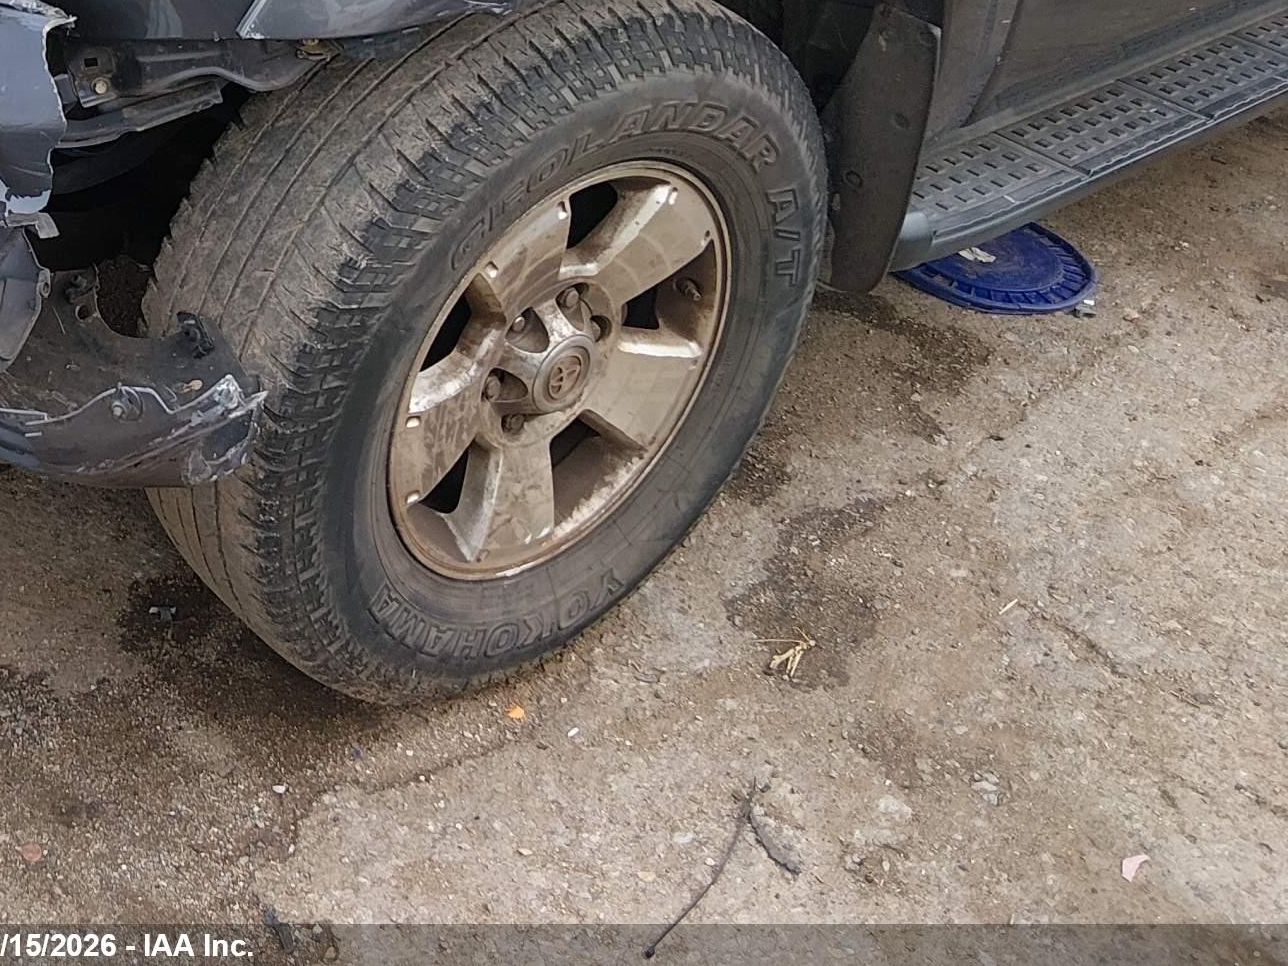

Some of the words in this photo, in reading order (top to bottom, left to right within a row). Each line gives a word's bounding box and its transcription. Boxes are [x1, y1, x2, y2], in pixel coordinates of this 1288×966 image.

[450, 100, 780, 272] GEOLANDAR
[764, 185, 804, 287] A/T
[367, 569, 625, 659] YOKOHAMA
